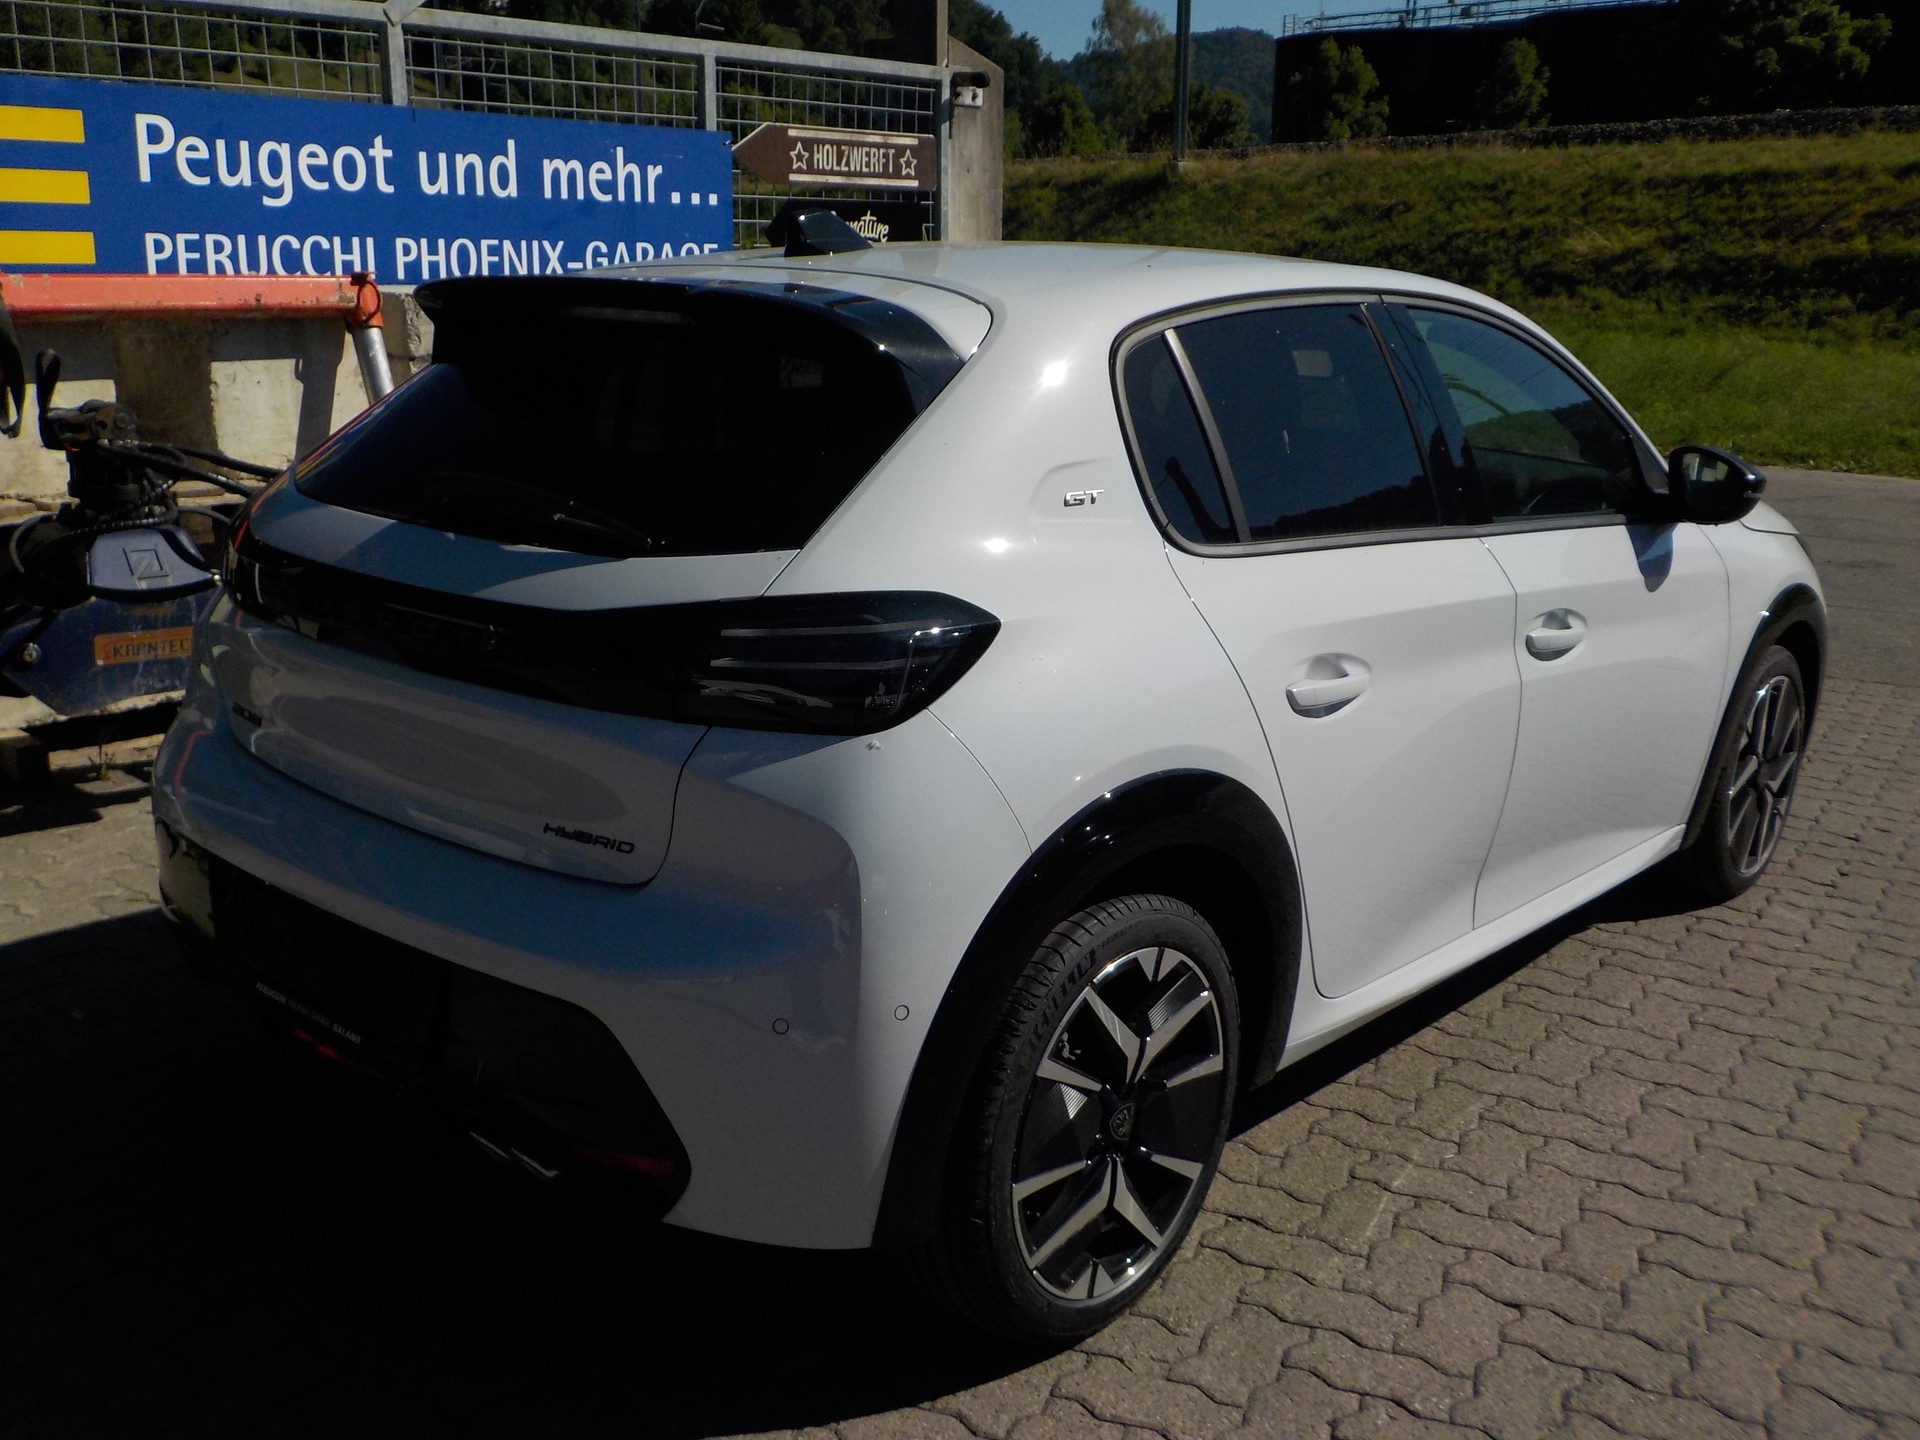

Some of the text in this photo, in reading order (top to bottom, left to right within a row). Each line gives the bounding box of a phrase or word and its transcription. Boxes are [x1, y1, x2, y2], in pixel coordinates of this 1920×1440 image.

[136, 113, 395, 207] Peugeot
[419, 139, 518, 198] und
[813, 143, 895, 174] HOLZWERFT
[145, 232, 376, 279] PERUCCHI
[1063, 489, 1105, 508] GT
[542, 822, 636, 855] HYBRID
